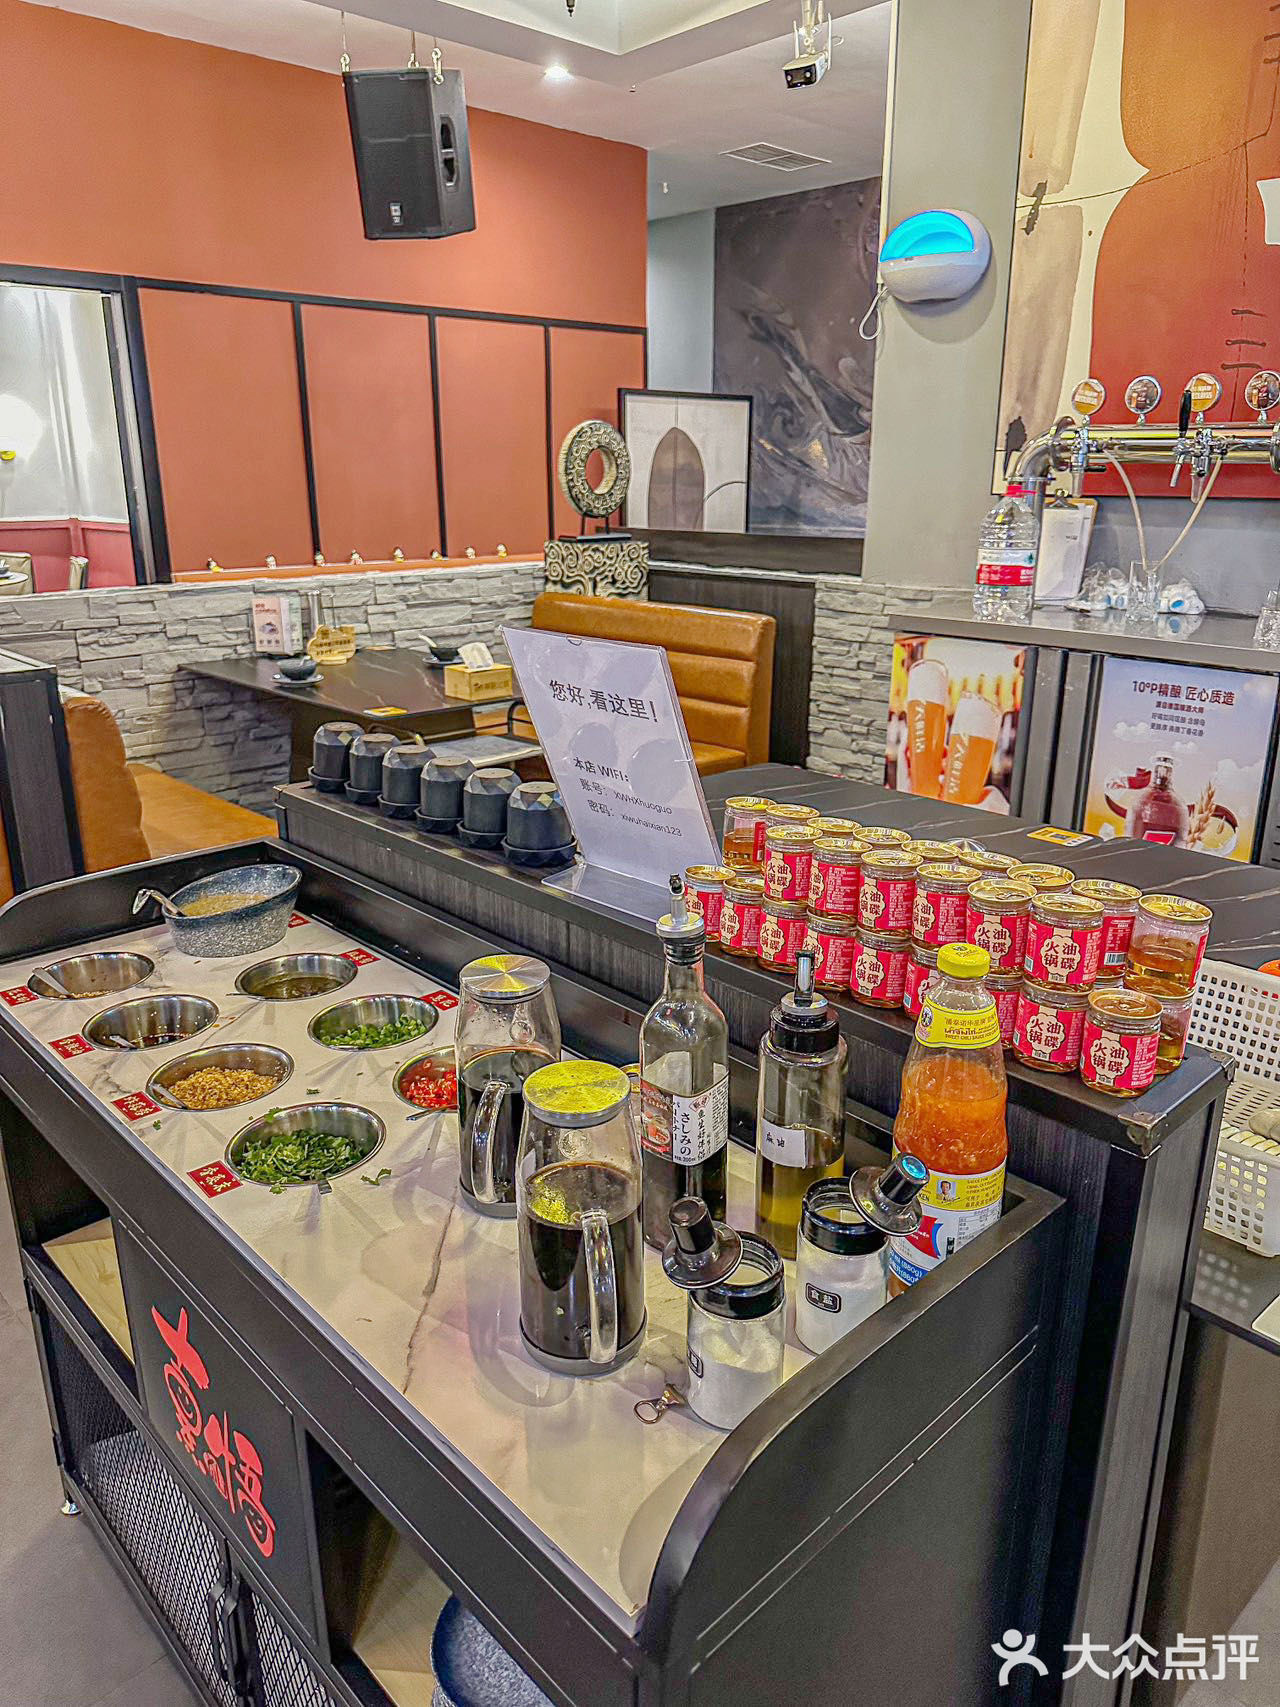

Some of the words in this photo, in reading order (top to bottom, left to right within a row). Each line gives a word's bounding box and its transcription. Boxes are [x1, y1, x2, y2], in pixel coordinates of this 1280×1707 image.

[1185, 686, 1235, 706] 匠心质造
[573, 757, 596, 774] 本店
[680, 1112, 692, 1156] さしみの
